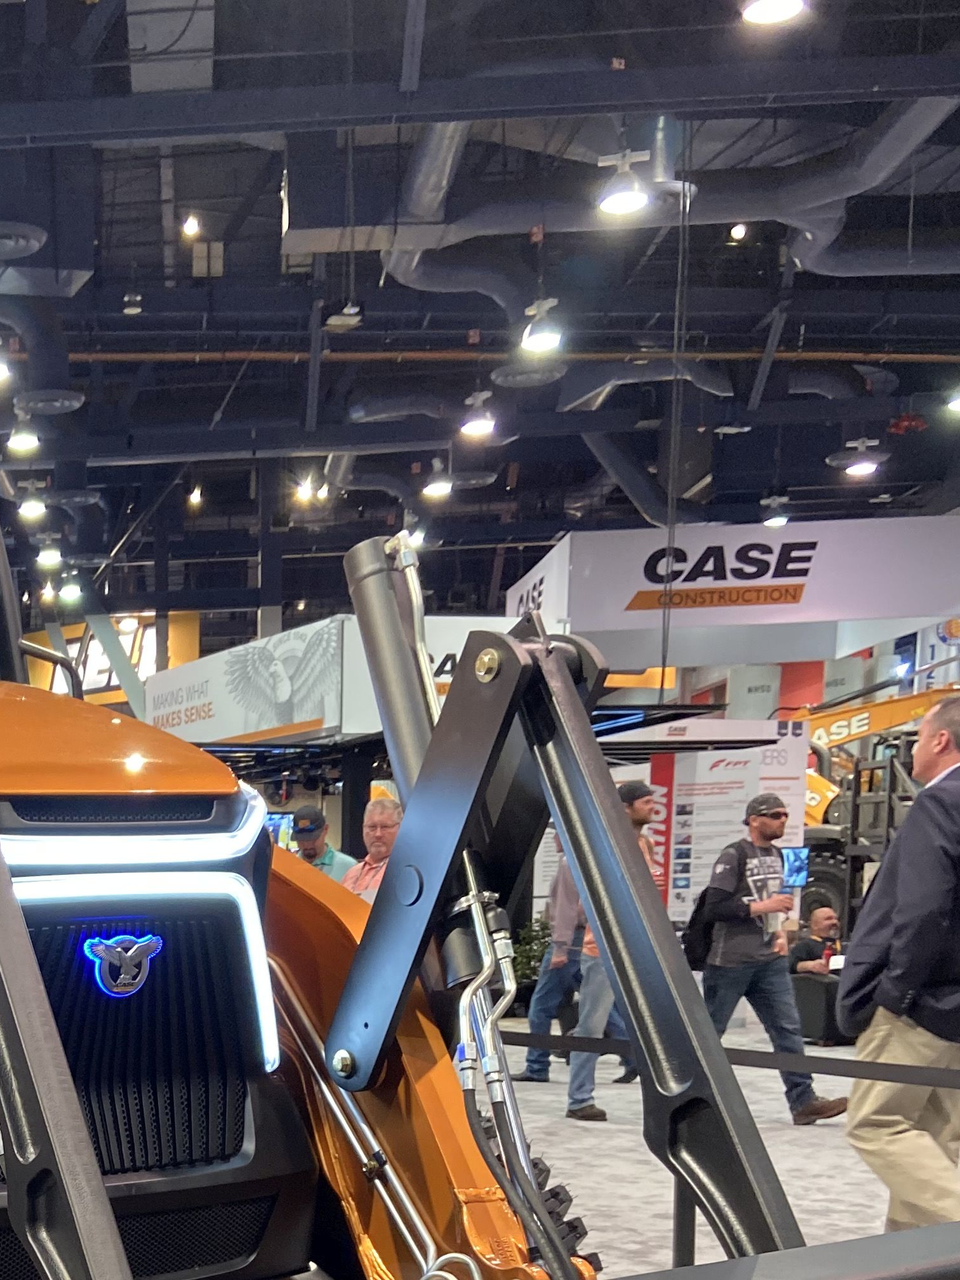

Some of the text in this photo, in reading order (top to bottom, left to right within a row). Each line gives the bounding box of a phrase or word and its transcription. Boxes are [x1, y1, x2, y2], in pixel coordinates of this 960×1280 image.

[643, 540, 819, 584] CASE
[656, 587, 798, 607] CONSTRUCTION
[152, 680, 210, 712] MAKING WHAT
[152, 702, 216, 730] MAKES SENSE.
[811, 711, 871, 745] ASE
